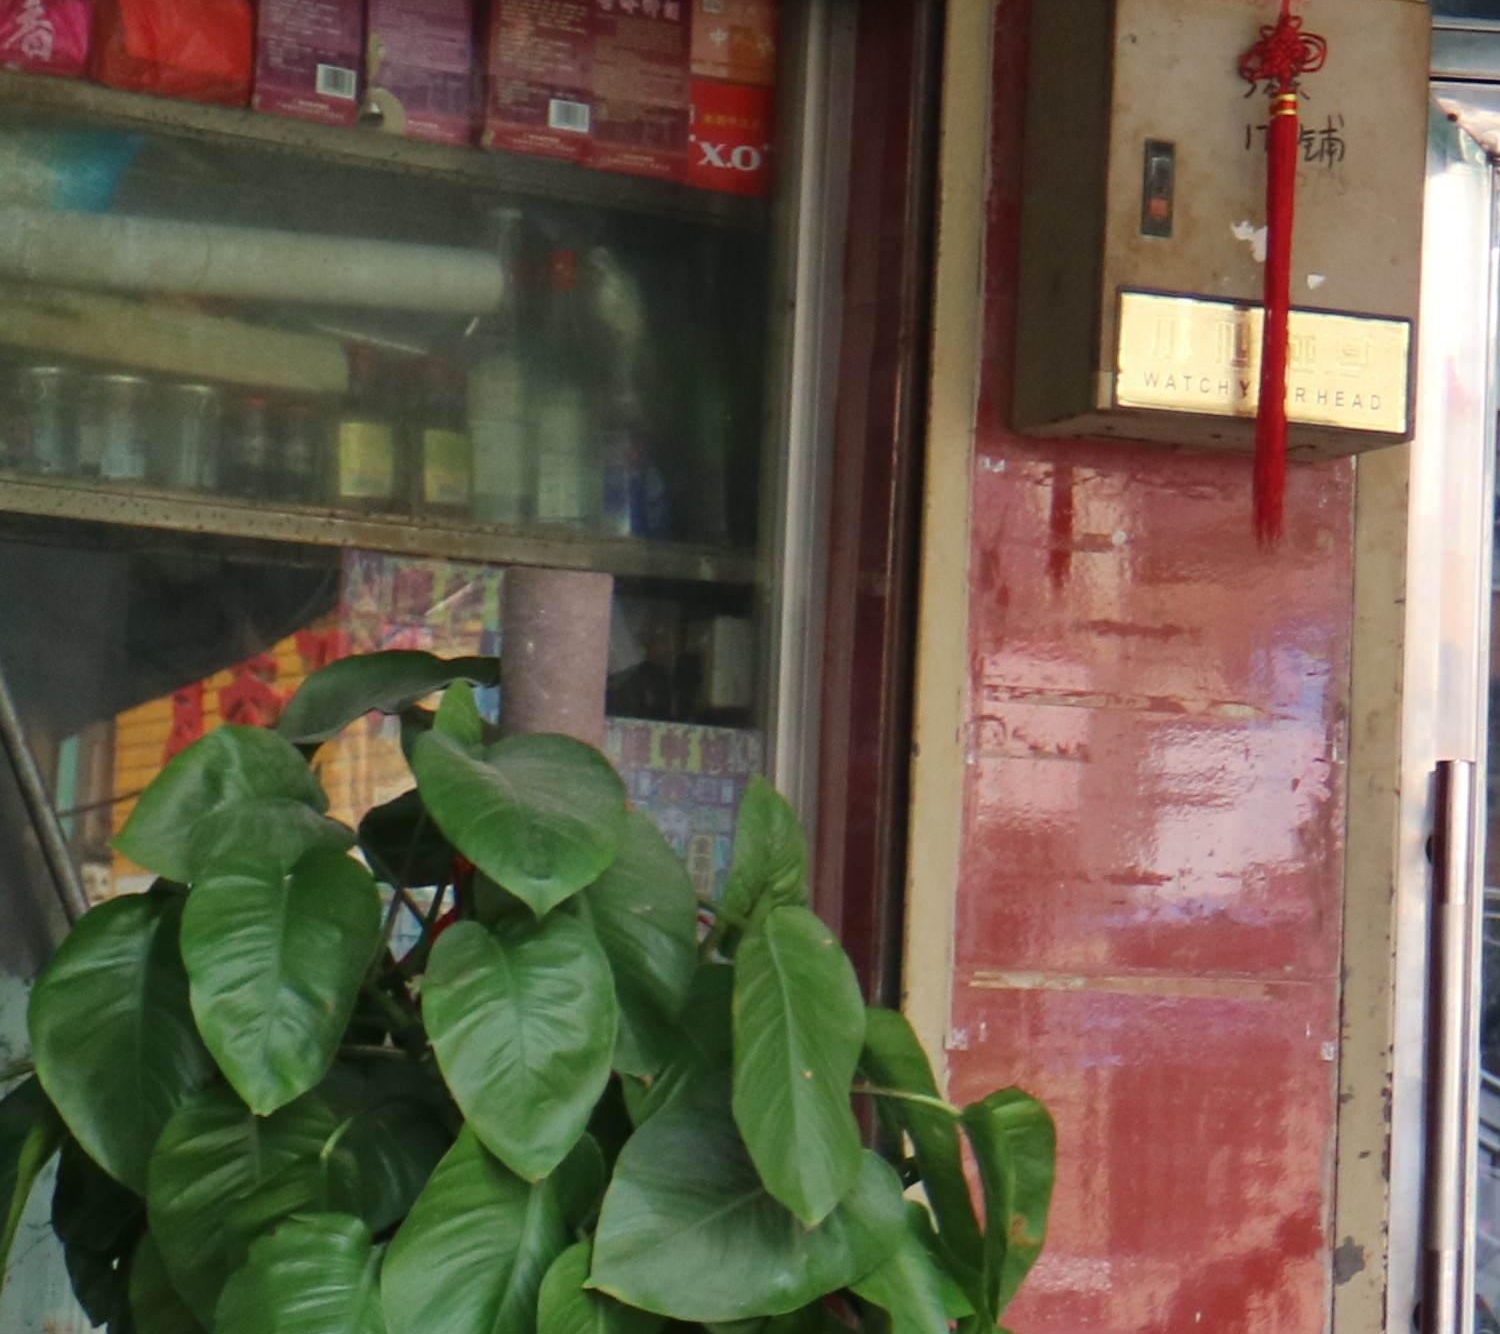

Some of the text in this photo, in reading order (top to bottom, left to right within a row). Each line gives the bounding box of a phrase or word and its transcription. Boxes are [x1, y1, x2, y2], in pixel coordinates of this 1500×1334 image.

[1143, 371, 1383, 413] WATCH YR HEAD
